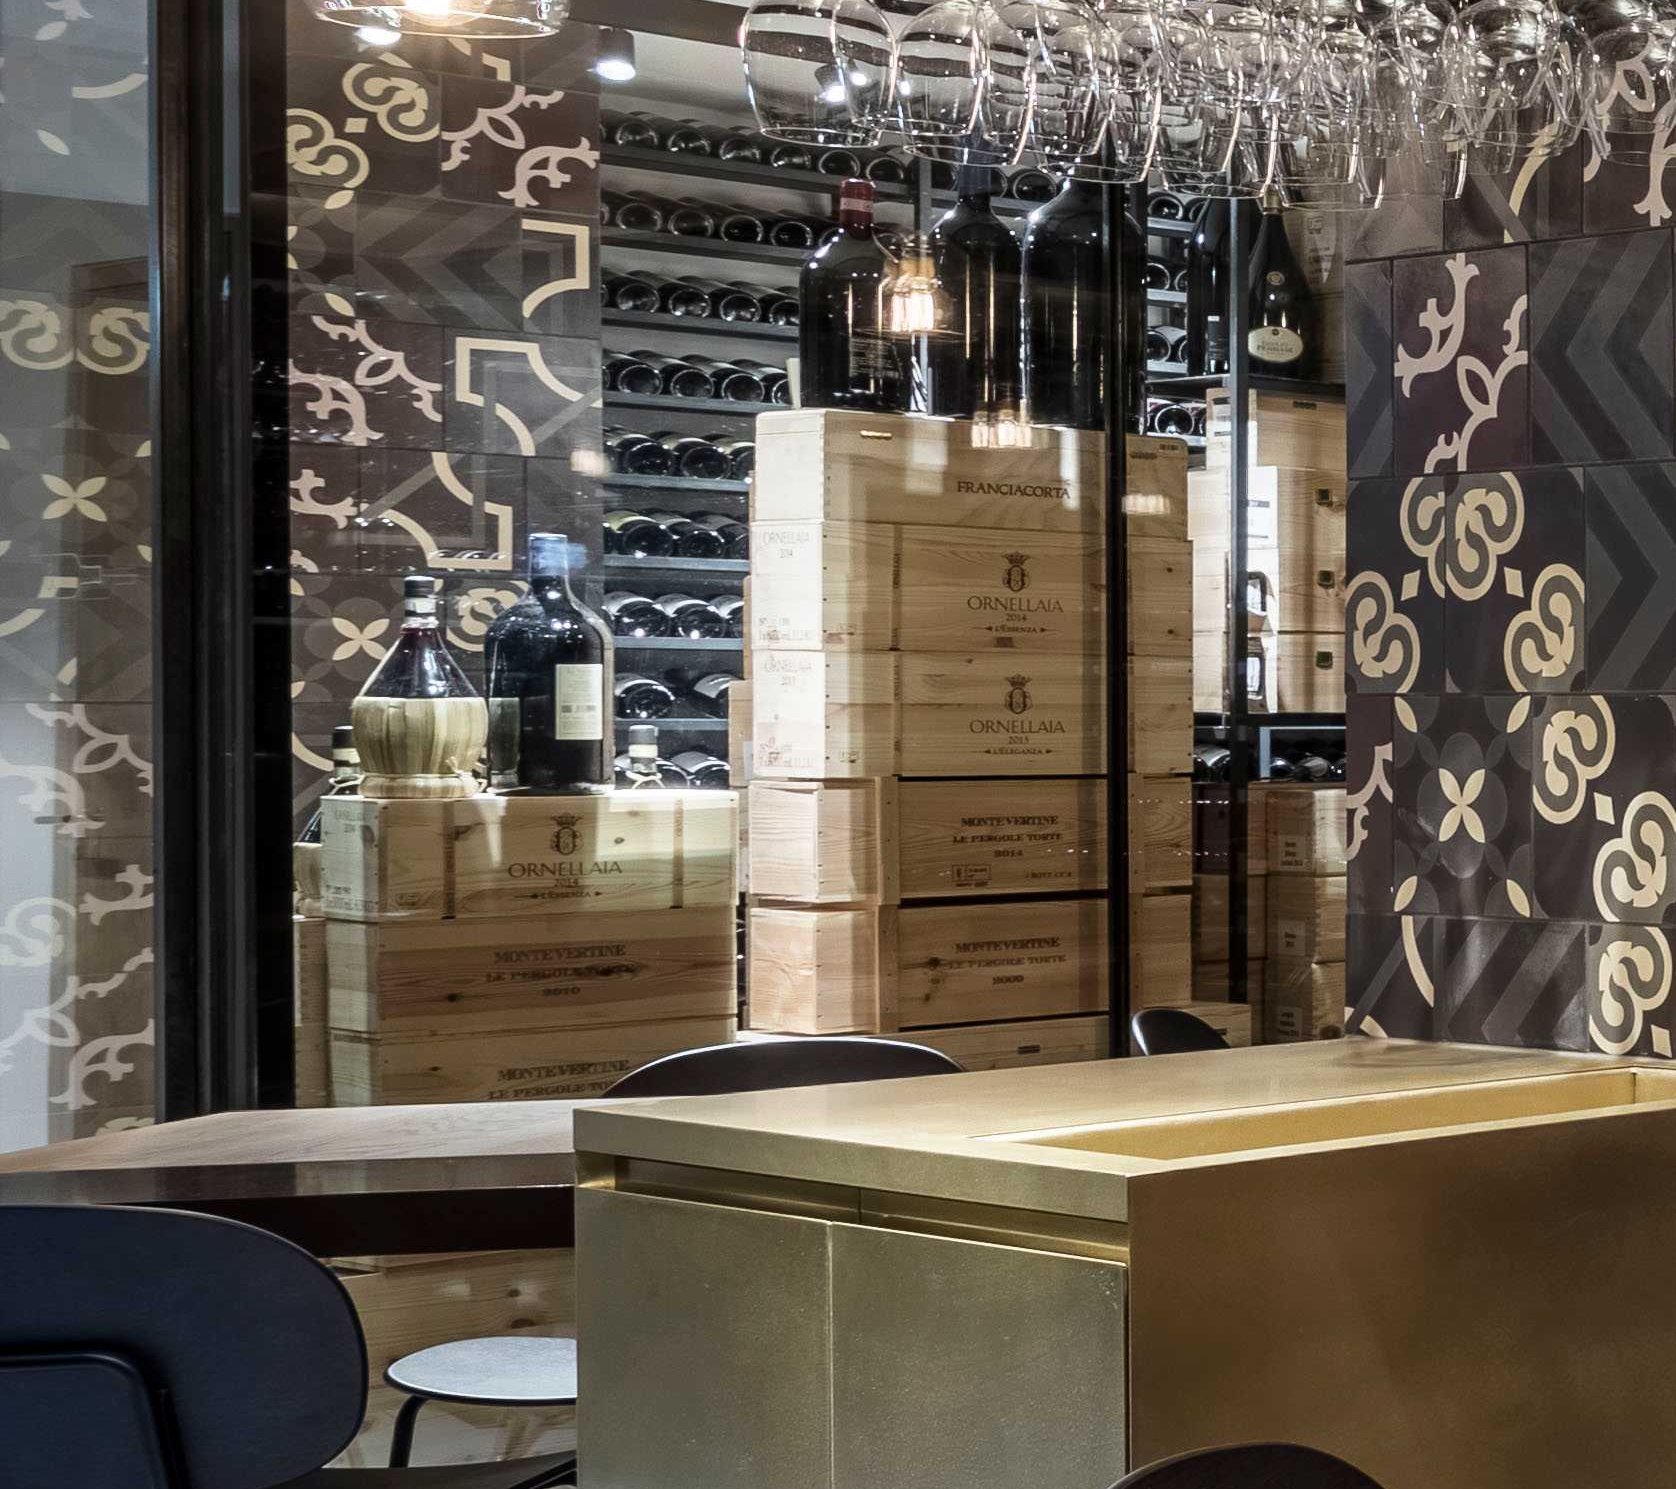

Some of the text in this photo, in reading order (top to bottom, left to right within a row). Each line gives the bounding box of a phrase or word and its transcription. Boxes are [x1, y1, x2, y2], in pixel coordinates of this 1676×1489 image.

[957, 481, 1070, 499] FRANCIACORTA
[967, 595, 1064, 613] ORNELLAIA
[969, 719, 1066, 734] ORNELLAIA
[960, 815, 1058, 827] MONTEVERTINE
[952, 835, 968, 844] LE
[971, 834, 1023, 843] PERGOLE
[507, 861, 623, 879] ORNELLAIA
[955, 937, 1061, 953] MONTEVERTINE
[494, 945, 626, 963] MONTEVERTINE
[497, 1060, 629, 1081] MONTEVERTINE
[514, 1084, 585, 1097] PERGOLE
